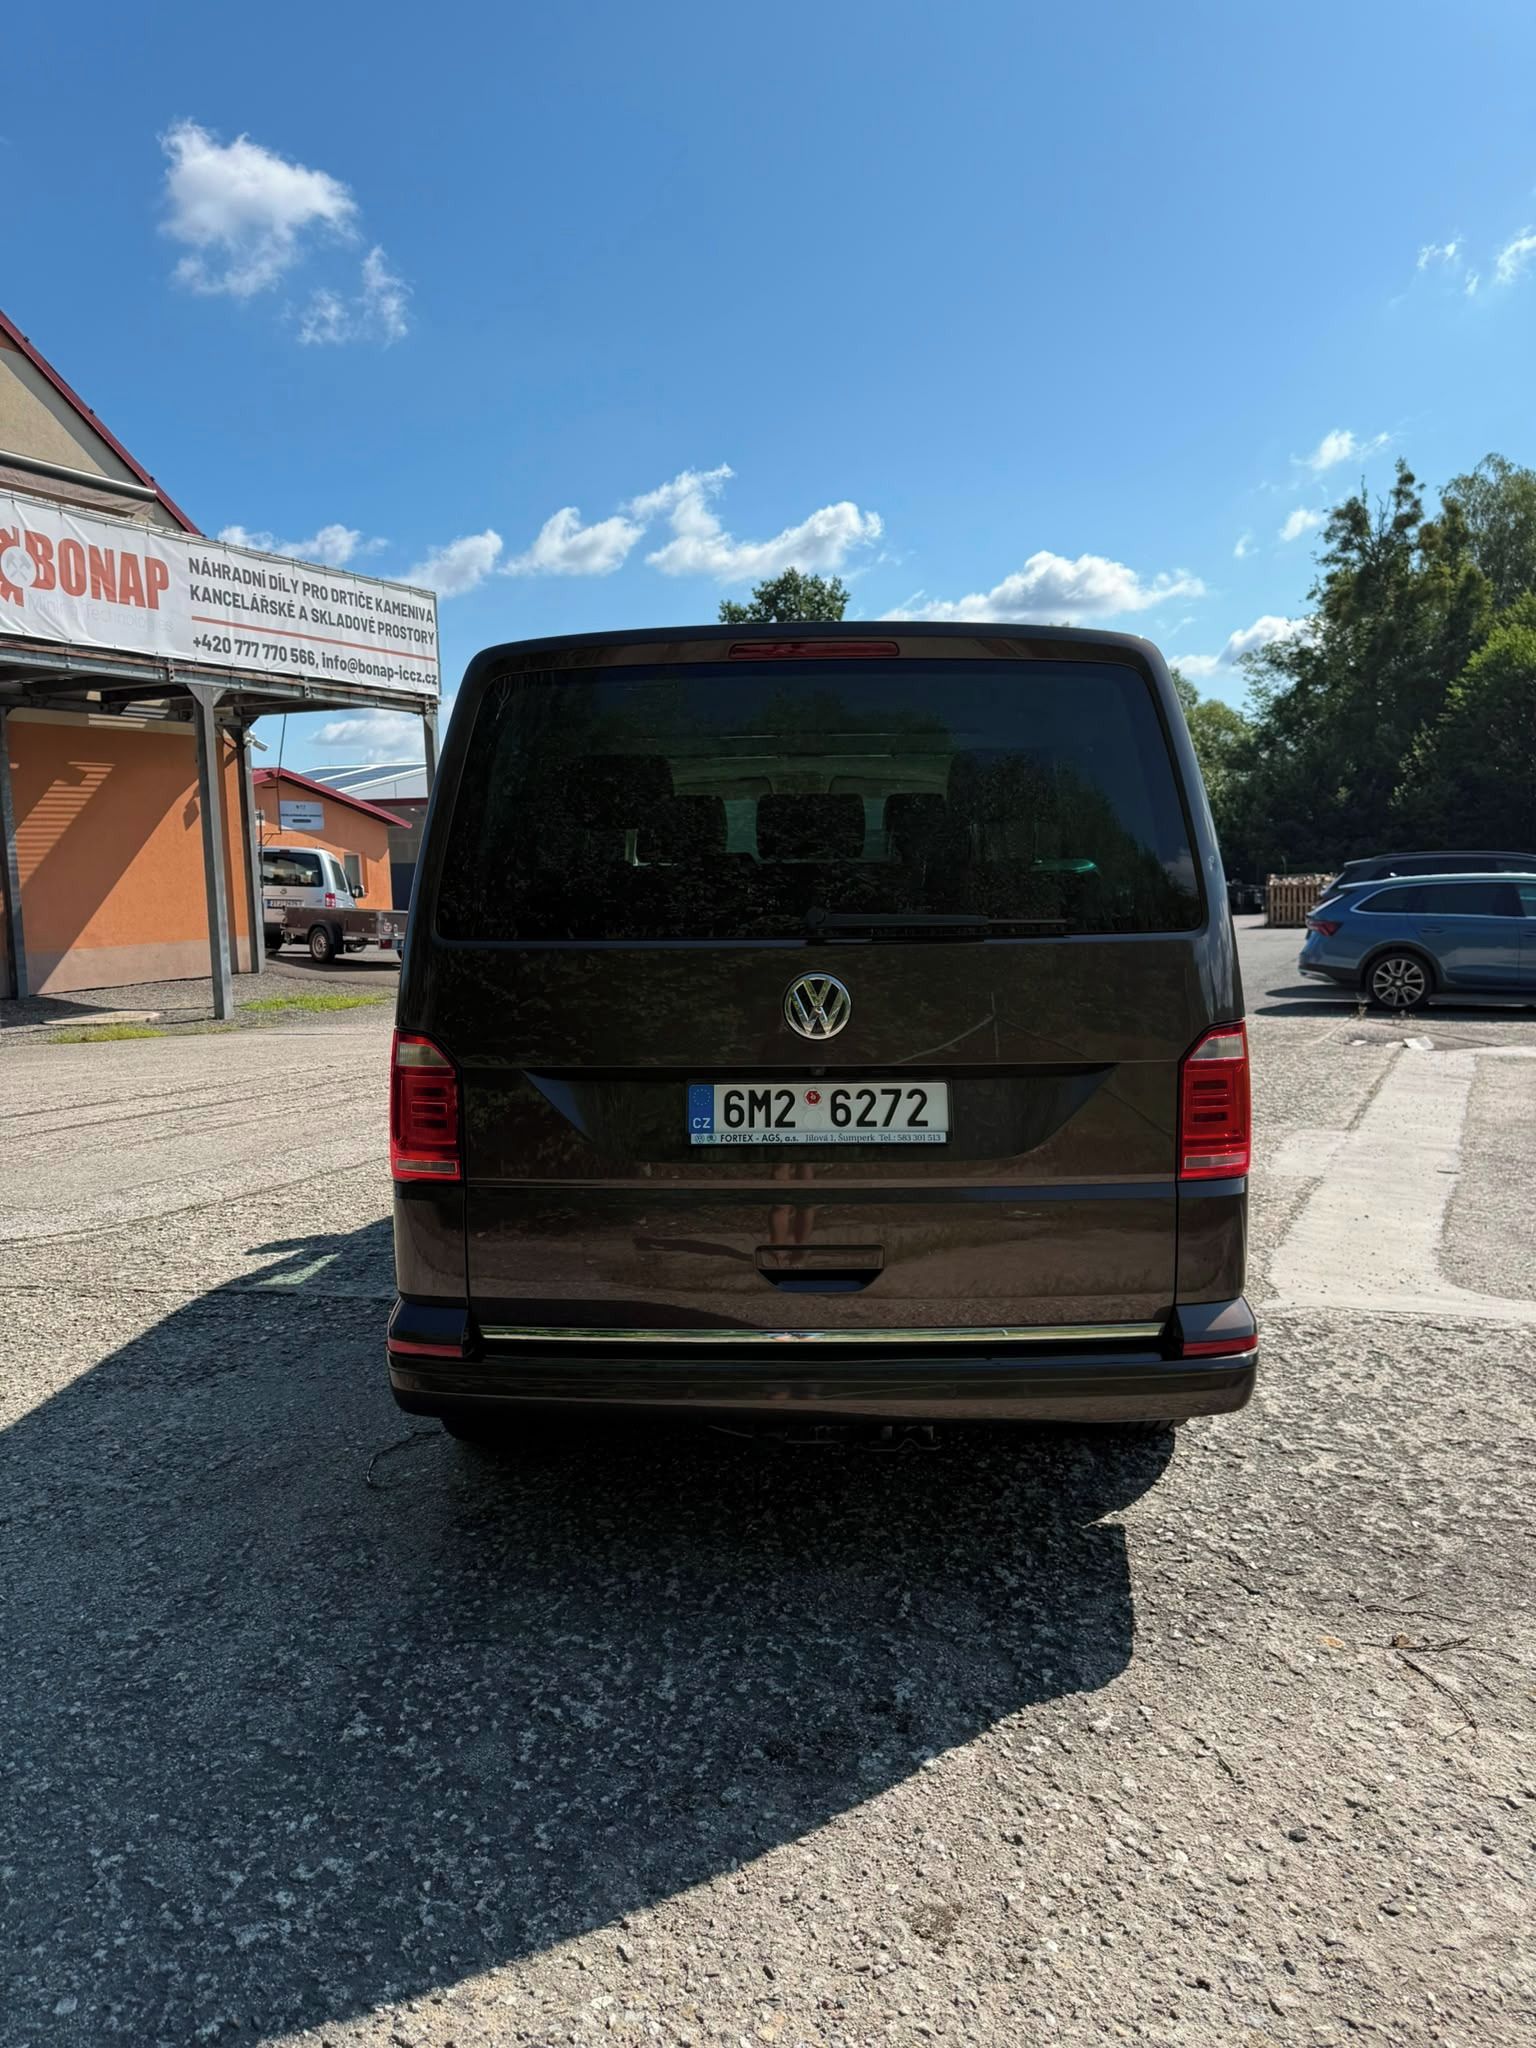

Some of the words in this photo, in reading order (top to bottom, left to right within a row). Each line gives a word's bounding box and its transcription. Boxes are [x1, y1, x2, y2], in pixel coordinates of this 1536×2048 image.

[24, 530, 169, 610] BONAP
[188, 556, 266, 588] NÁHRADNÍ
[268, 572, 298, 594] DÍLY
[302, 581, 328, 601] PRO
[331, 588, 373, 611] DRTIČE
[375, 597, 434, 624] KAMENIVA
[190, 584, 296, 619] KANCELÁŘSKÉ
[298, 605, 309, 621] A
[311, 607, 375, 634] SKLADOVÉ
[378, 621, 435, 645] PROSTORY
[193, 633, 232, 654] +420
[234, 638, 260, 659] 777
[262, 643, 288, 662] 770
[290, 647, 319, 669] 566,
[321, 651, 438, 685] info@bonap-iccz.cz
[692, 1117, 711, 1129] CZ
[724, 1089, 796, 1129] 6M2
[830, 1088, 929, 1128] 6272
[720, 1134, 753, 1143] FORTEX
[761, 1134, 783, 1144] AGS,
[838, 1132, 875, 1144] Šumperk
[897, 1134, 912, 1142] 583
[913, 1134, 926, 1142] 301
[928, 1134, 941, 1142] 513
